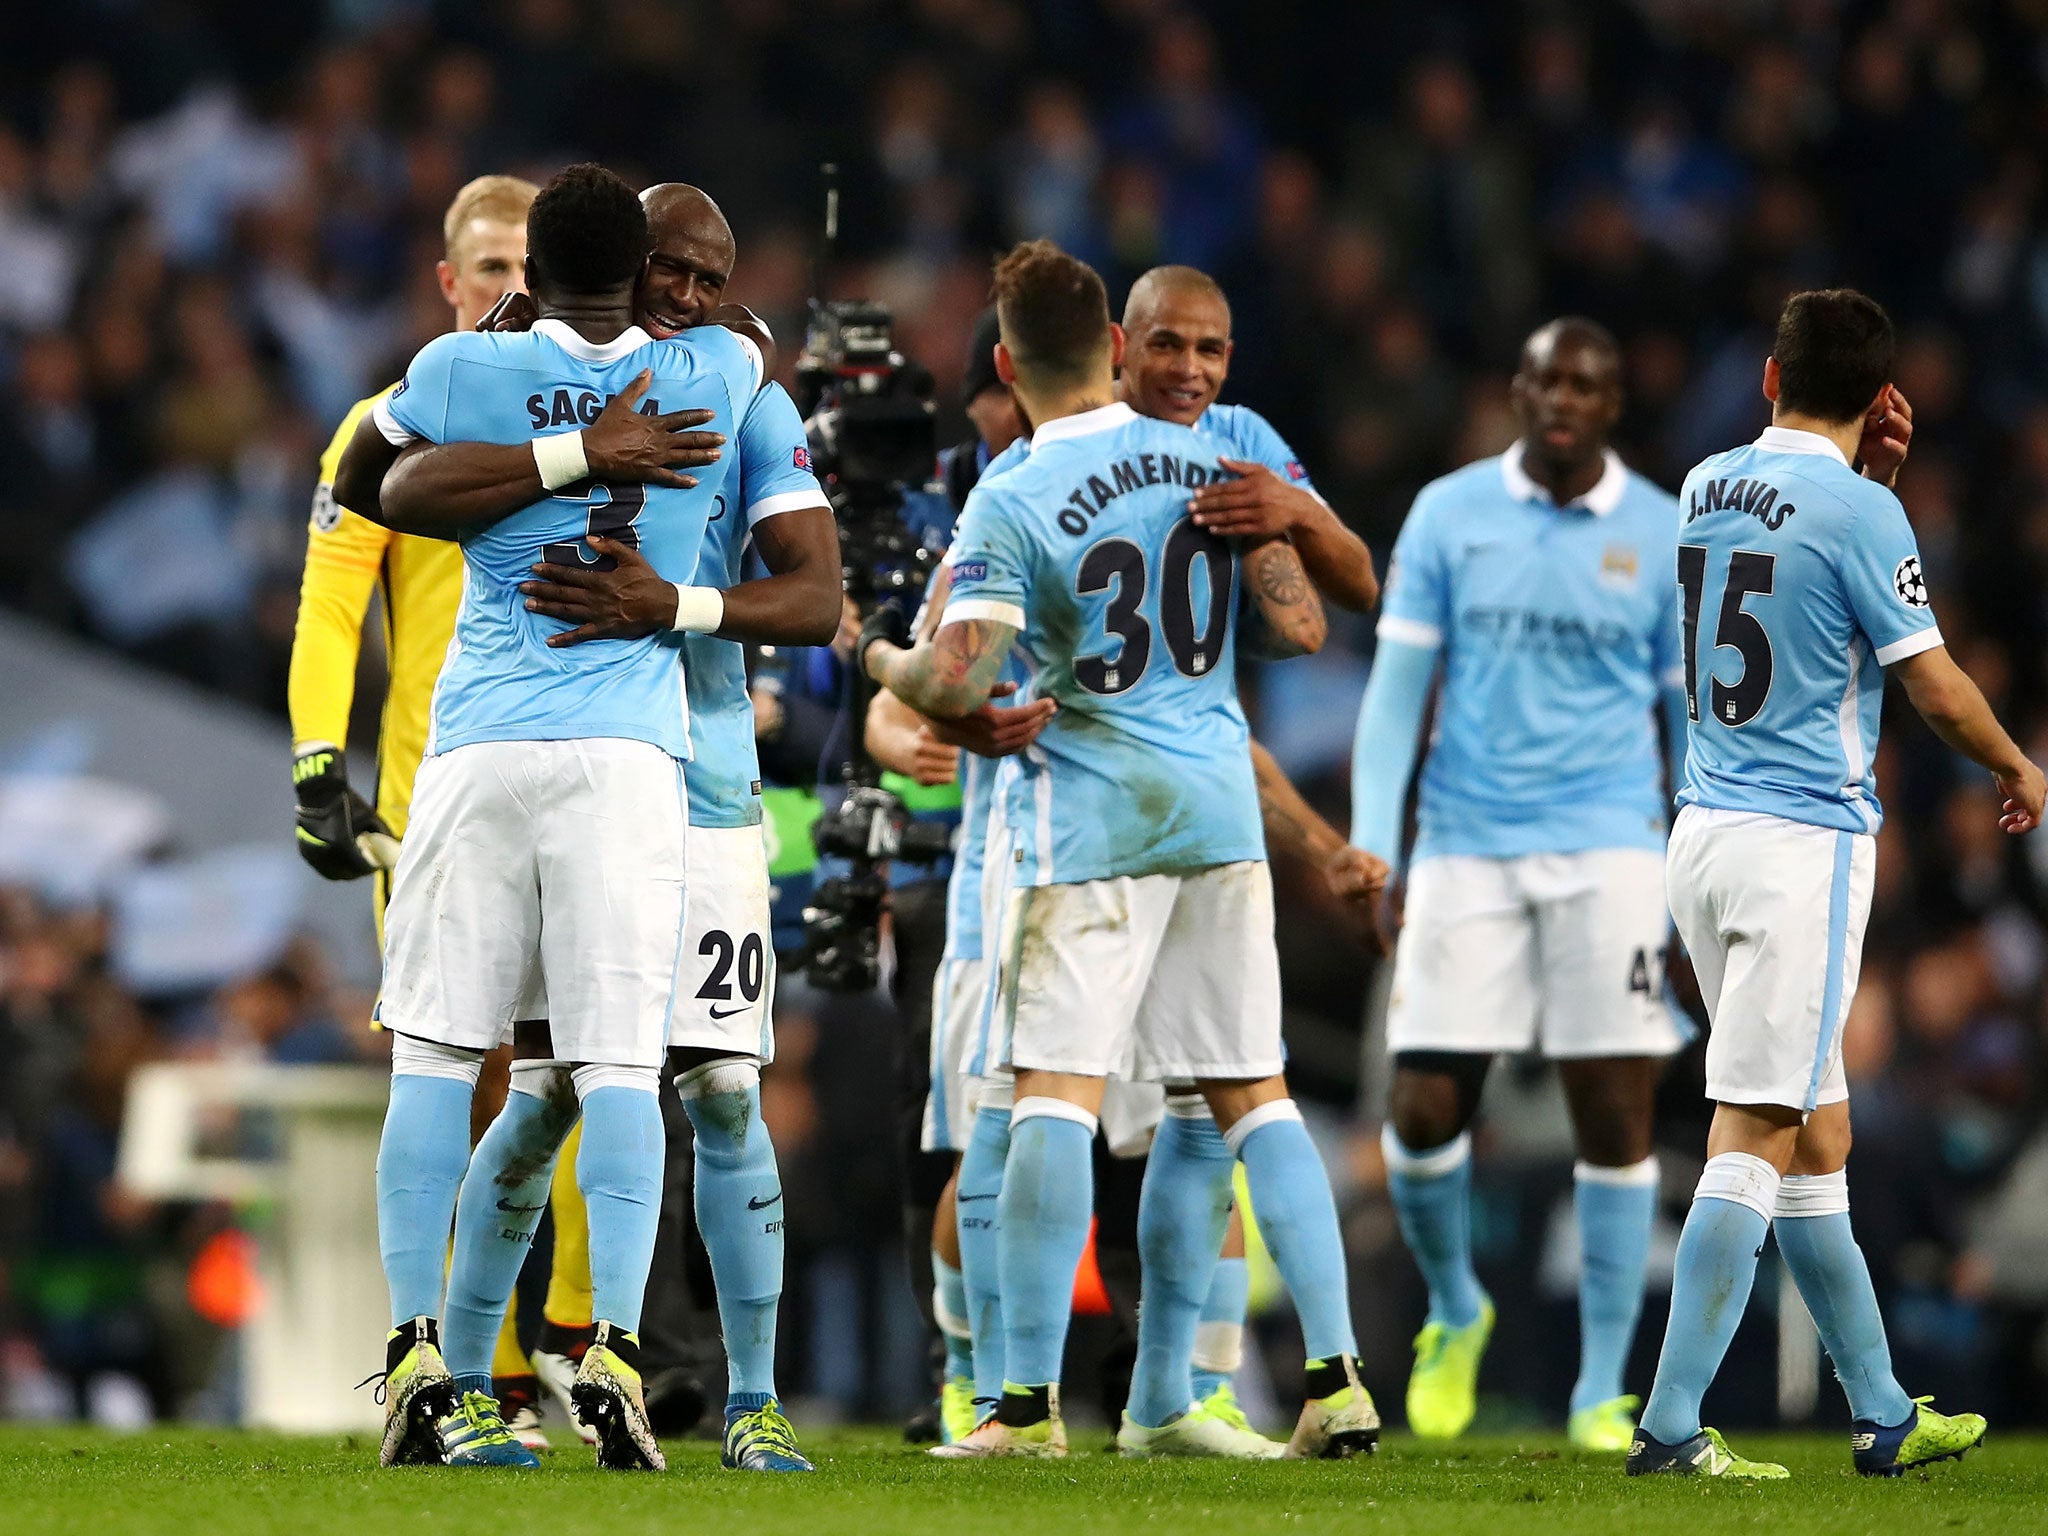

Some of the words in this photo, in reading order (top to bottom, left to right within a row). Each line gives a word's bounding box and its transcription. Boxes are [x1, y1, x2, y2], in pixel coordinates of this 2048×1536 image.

[526, 389, 661, 430] SAGA
[1687, 478, 1795, 532] J.NAVAS
[1072, 514, 1235, 697] 30
[1677, 543, 1777, 728] 15
[694, 929, 763, 1002] 20
[502, 1228, 534, 1242] CITY
